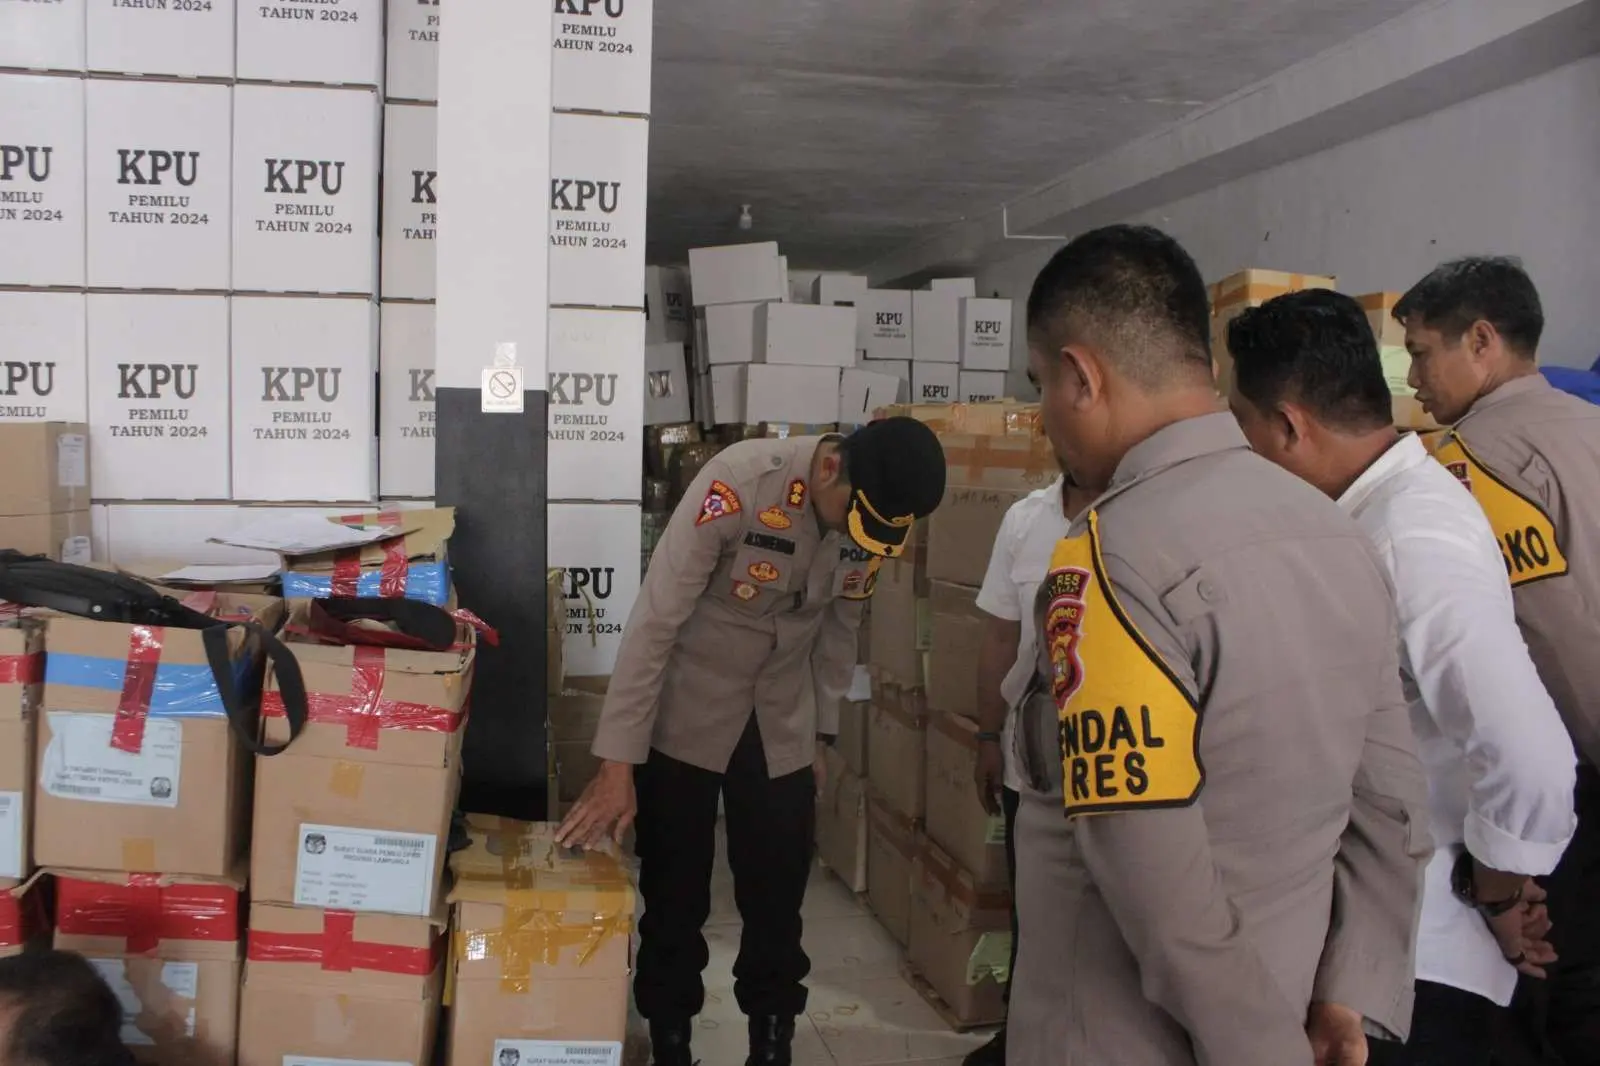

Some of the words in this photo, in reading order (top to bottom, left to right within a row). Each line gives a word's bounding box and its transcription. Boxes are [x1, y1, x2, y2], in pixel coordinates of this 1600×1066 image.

[172, 0, 213, 12] 2024
[260, 7, 314, 20] TAHUN
[320, 10, 359, 22] 2024
[408, 29, 439, 42] TAH
[562, 24, 617, 37] PEMILU
[553, 38, 593, 51] AHUN
[598, 42, 633, 53] 2024
[0, 145, 53, 182] PU
[117, 149, 200, 186] KPU
[264, 158, 345, 196] KPU
[0, 191, 43, 203] MILU
[128, 195, 190, 208] PEMILU
[551, 178, 621, 213] KPU
[23, 209, 64, 221] 2024
[275, 204, 335, 217] PEMILU
[109, 211, 164, 224] TAHUN
[170, 212, 209, 225] 2024
[255, 220, 310, 233] TAHUN
[314, 222, 353, 235] 2024
[556, 220, 611, 232] PEMILU
[402, 228, 437, 240] TAH
[550, 235, 588, 247] AHUN
[592, 237, 627, 249] 2024
[876, 312, 903, 326] KPU
[974, 320, 1002, 333] KPU
[0, 361, 56, 397] PU
[117, 363, 199, 400] KPU
[261, 367, 342, 403] KPU
[547, 372, 618, 406] KPU
[923, 384, 950, 398] KPU
[0, 406, 47, 417] EMILU
[128, 408, 189, 421] PEMILU
[272, 411, 332, 423] PEMILU
[553, 414, 608, 425] PEMILU
[110, 425, 165, 438] TAHUN
[170, 425, 208, 438] 2024
[253, 427, 308, 440] TAHUN
[312, 427, 351, 440] 2024
[401, 427, 436, 438] TAH
[548, 430, 585, 441] AHUN
[590, 431, 625, 442] 2024
[839, 547, 869, 562] POL
[562, 567, 615, 599] PU
[1058, 704, 1165, 760] ENDAL
[1067, 751, 1150, 801] RES
